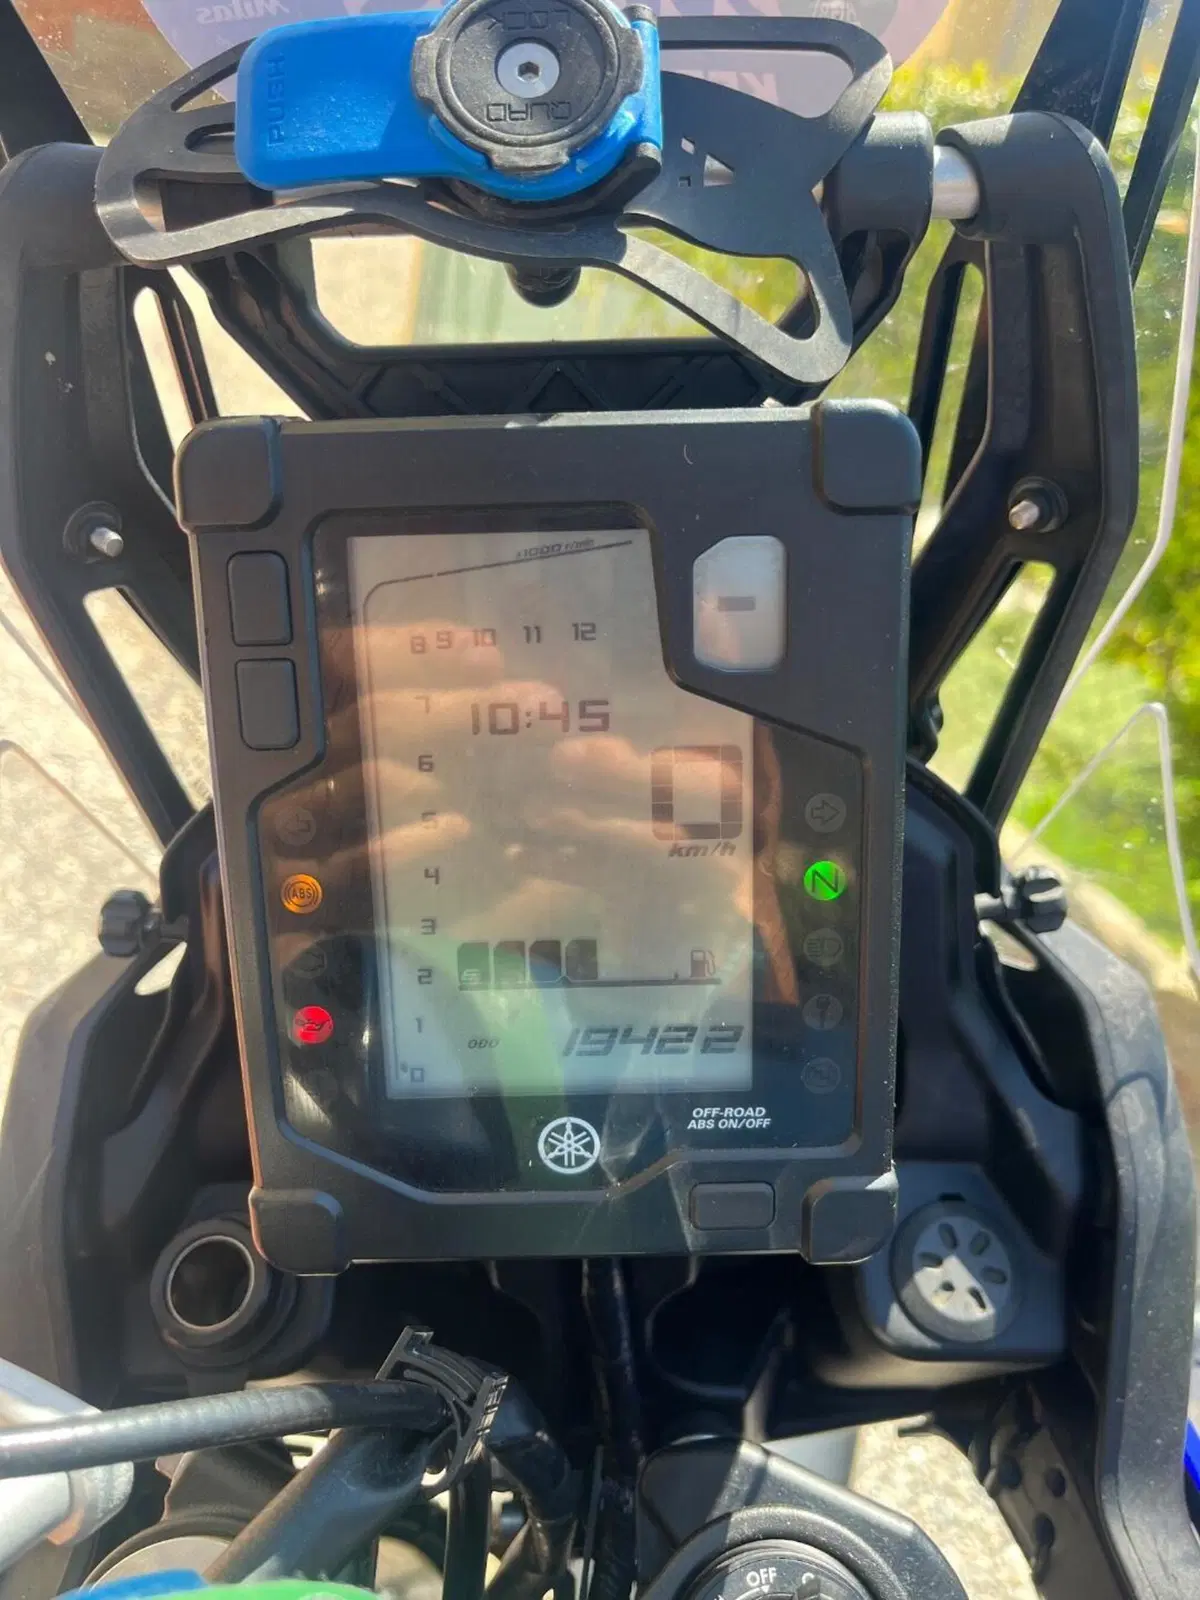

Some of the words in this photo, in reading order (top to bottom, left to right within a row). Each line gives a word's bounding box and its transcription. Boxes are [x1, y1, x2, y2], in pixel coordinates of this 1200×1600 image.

[487, 10, 571, 30] LOCK
[267, 56, 284, 146] PUSH
[486, 102, 572, 121] QUAD
[411, 636, 427, 654] 8
[436, 631, 452, 649] 9
[472, 628, 496, 646] 10
[523, 625, 542, 644] 11
[572, 622, 597, 641] 12
[471, 700, 610, 735] 10:45
[418, 755, 433, 772] 6
[668, 842, 737, 858] km/h
[424, 868, 440, 885] 4
[811, 867, 839, 893] N
[292, 888, 313, 899] ABS
[421, 918, 437, 935] 3
[417, 968, 433, 985] 2
[416, 1017, 423, 1033] 1
[562, 1025, 744, 1057] 19422
[692, 1107, 766, 1118] OFF-ROAD
[687, 1119, 715, 1129] ABS
[718, 1118, 772, 1129] ON/OFF
[746, 1567, 777, 1587] OFF
